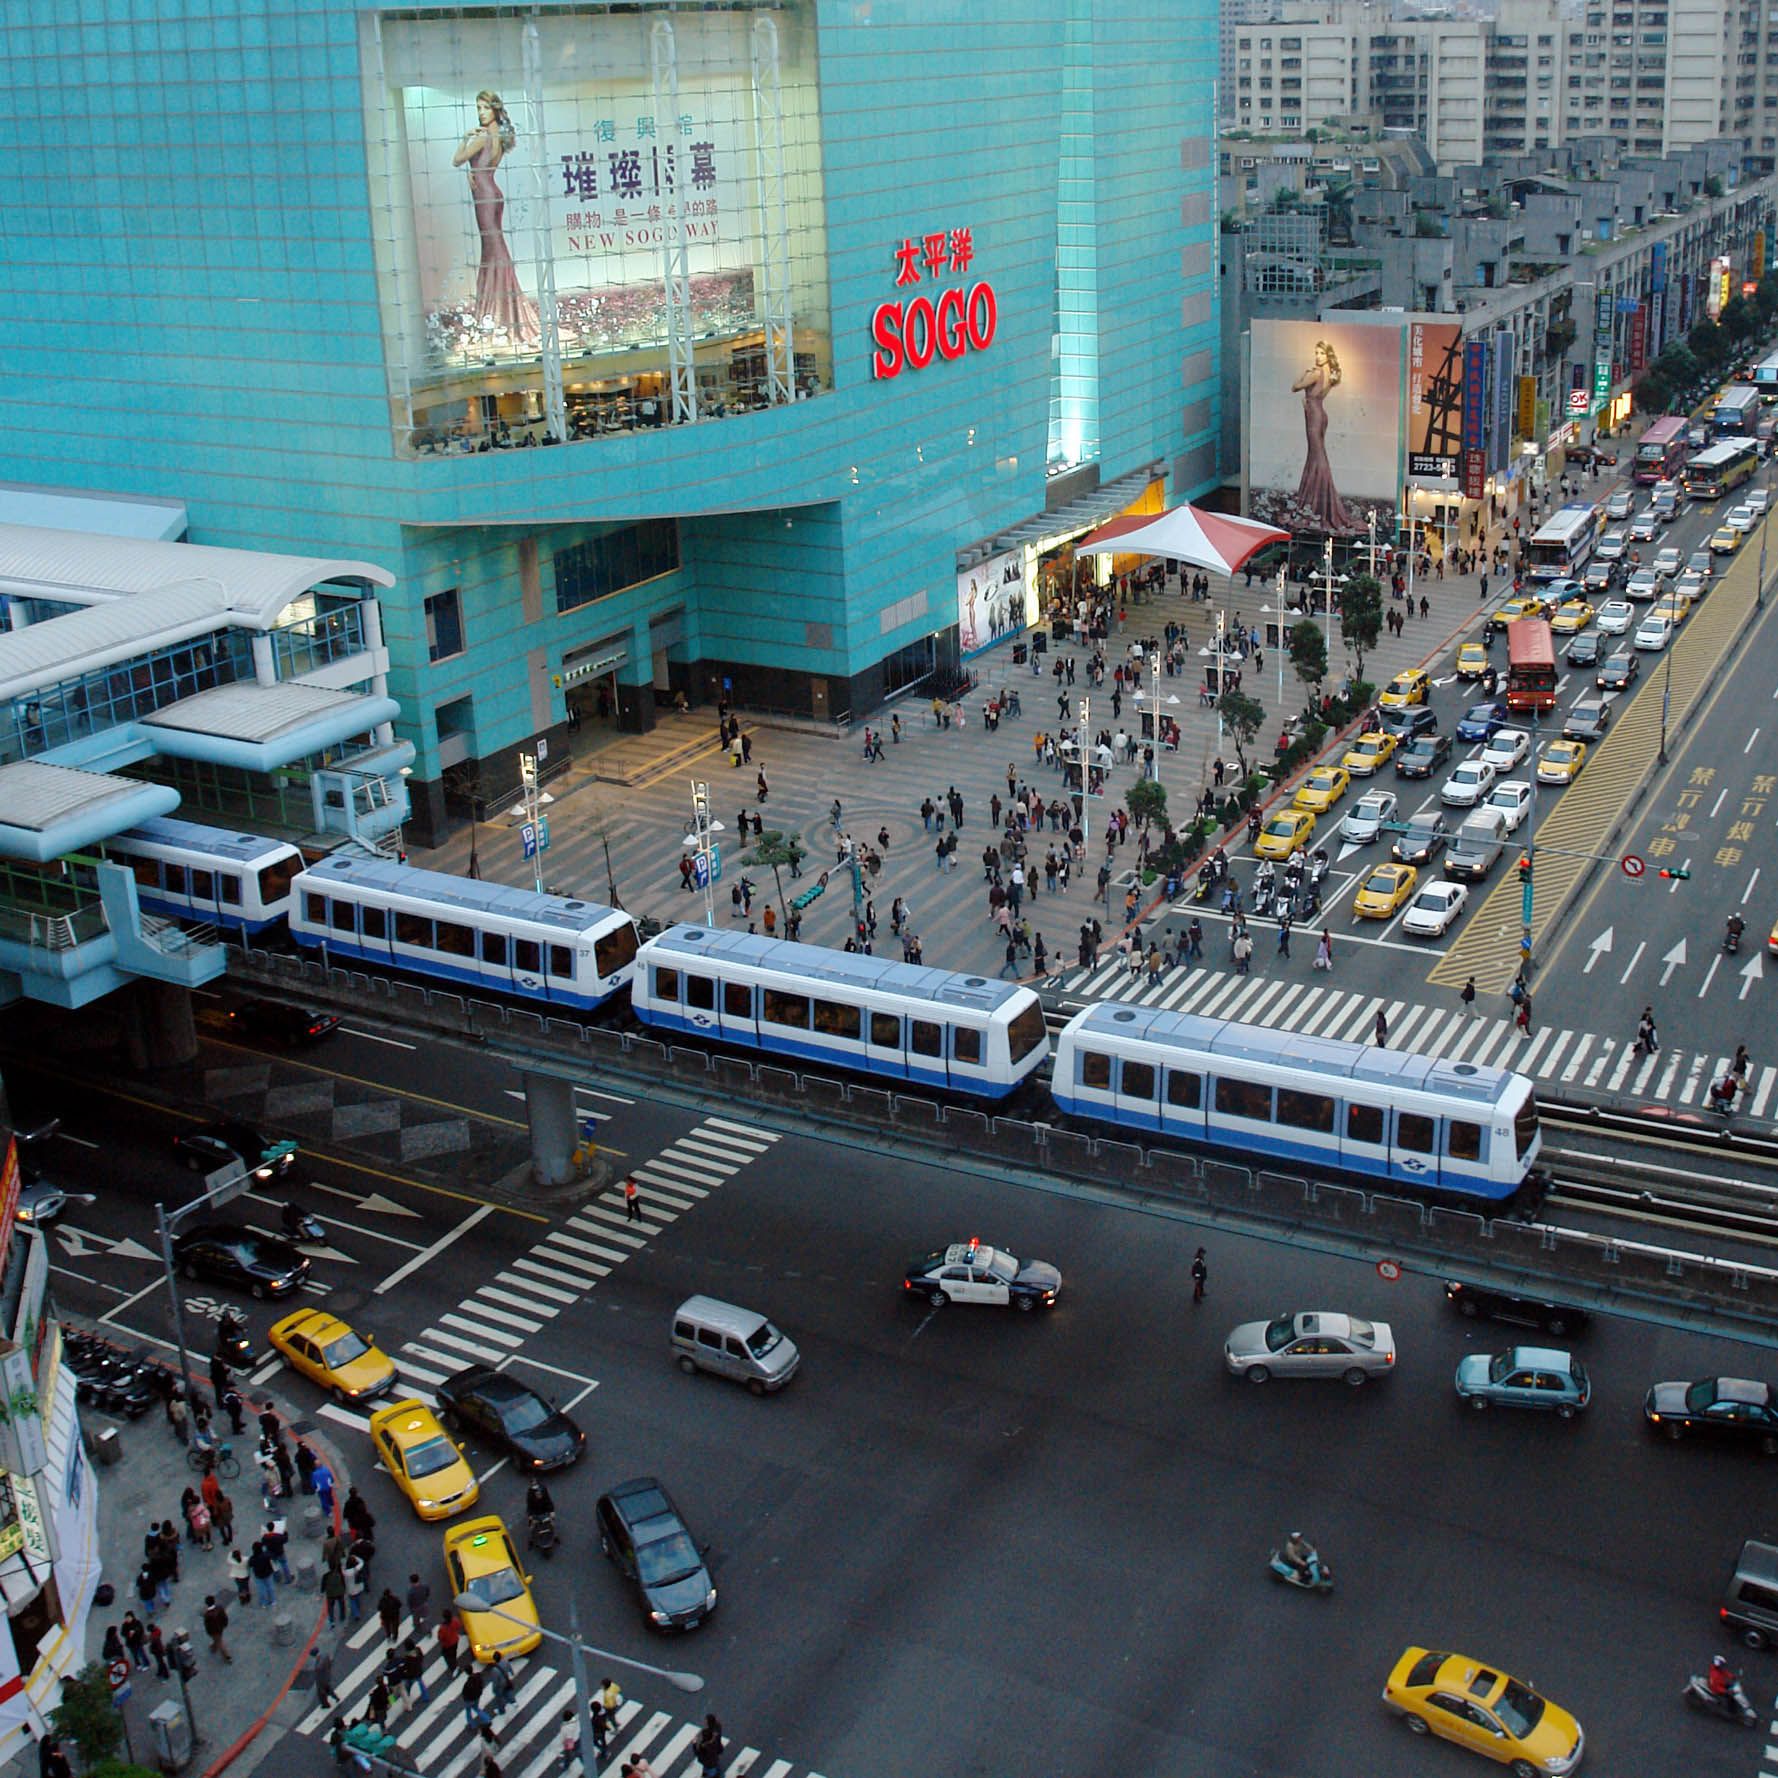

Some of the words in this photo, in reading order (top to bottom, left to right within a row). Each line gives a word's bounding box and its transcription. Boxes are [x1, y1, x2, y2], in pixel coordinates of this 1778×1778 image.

[568, 232, 615, 252] NEW
[625, 225, 678, 246] SOGO
[685, 220, 719, 239] WAY
[895, 227, 974, 287] 太平洋
[872, 281, 997, 379] SOGO
[1713, 775, 1777, 868] 禁行機車
[579, 949, 590, 957] 37
